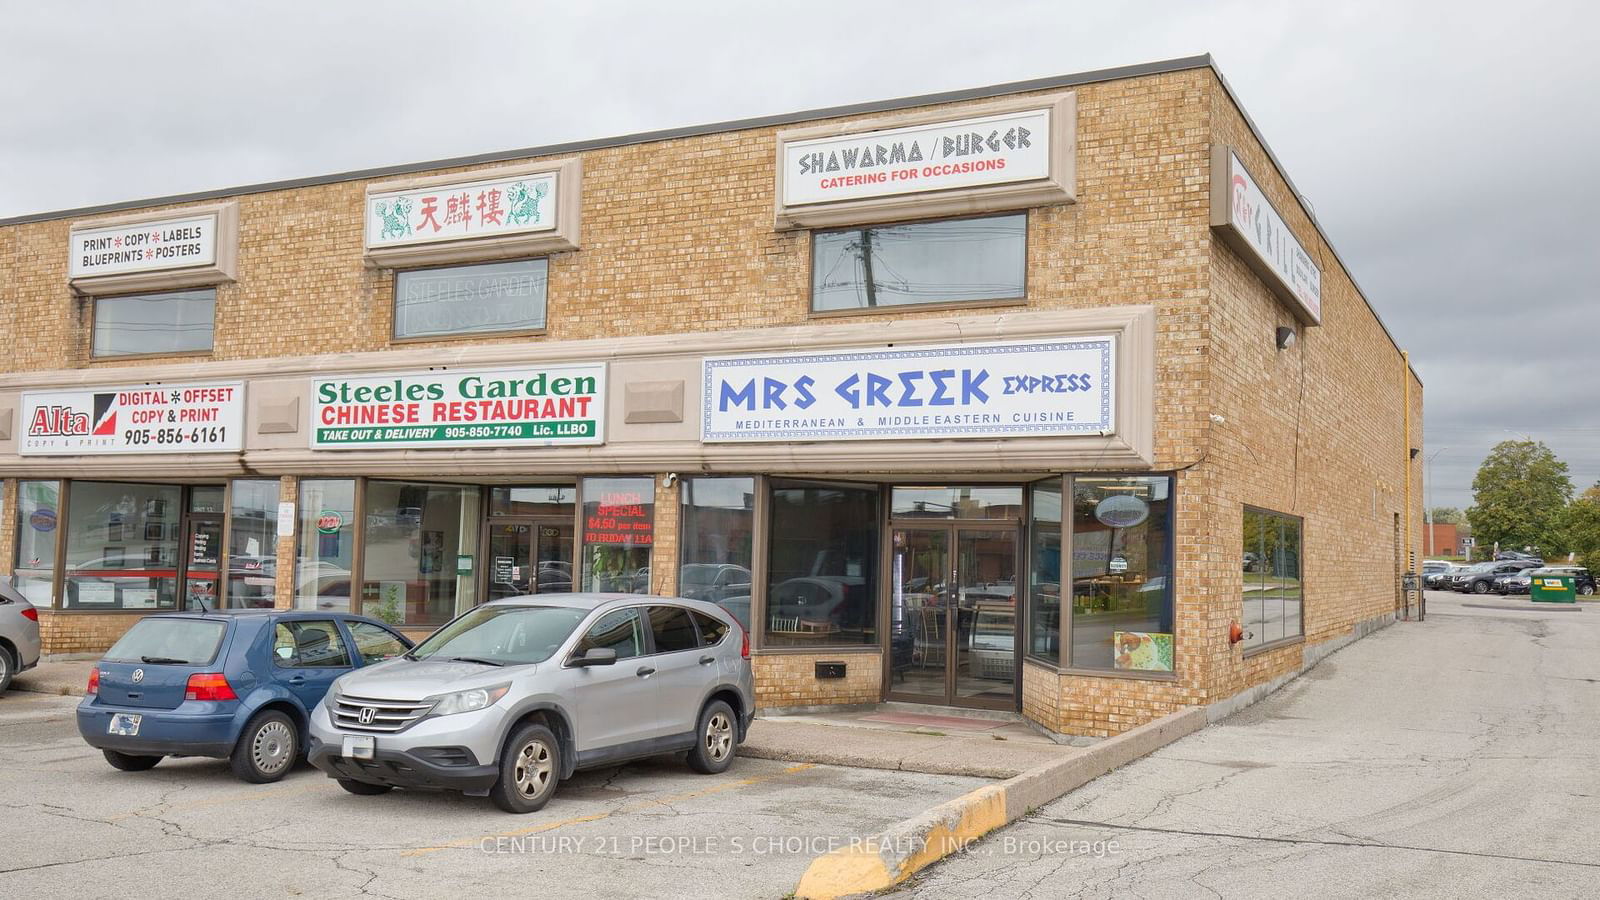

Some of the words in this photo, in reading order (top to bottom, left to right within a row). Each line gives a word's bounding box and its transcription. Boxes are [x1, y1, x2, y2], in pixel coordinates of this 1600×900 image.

[798, 139, 924, 176] SHAWARMA
[942, 126, 1032, 159] BURGER
[820, 172, 887, 190] CATERING
[891, 168, 918, 182] FOR
[922, 158, 1006, 178] OCCASIONS
[83, 238, 112, 252] PRINT
[124, 232, 150, 247] COPY
[162, 227, 202, 243] LABELS
[83, 250, 143, 267] BLUEPRINTS
[155, 243, 201, 259] POSTERS
[407, 279, 475, 304] STEELES
[478, 274, 541, 300] GARDEN
[119, 390, 168, 407] DIGITAL
[183, 388, 234, 404] OFFSET
[318, 379, 445, 405] Steeles
[458, 373, 597, 399] Garden
[718, 374, 817, 413] MRS
[1002, 372, 1092, 396] EXPRESS
[28, 405, 90, 437] Alta
[132, 409, 164, 424] COPY
[167, 409, 177, 424] &
[180, 407, 219, 423] PRINT
[321, 403, 420, 426] CHINESE
[432, 397, 592, 422] RESTAURANT
[735, 417, 846, 429] MEDITERRANEAN
[857, 417, 865, 427] &
[878, 415, 934, 427] MIDDLE
[935, 413, 1001, 426] EASTERN
[1012, 411, 1075, 424] CUISINE
[27, 440, 55, 448] COPY
[65, 439, 70, 447] &
[80, 438, 116, 447] PRINT
[124, 426, 226, 446] 905-856-6161
[322, 430, 349, 441] TAKE
[351, 428, 373, 440] OUT
[374, 428, 383, 440] &
[385, 427, 438, 440] DELIVERY
[445, 425, 522, 438] 905-850-7740
[532, 424, 554, 437] Lic.
[557, 423, 588, 435] LLBO
[597, 504, 646, 517] SPECIAL
